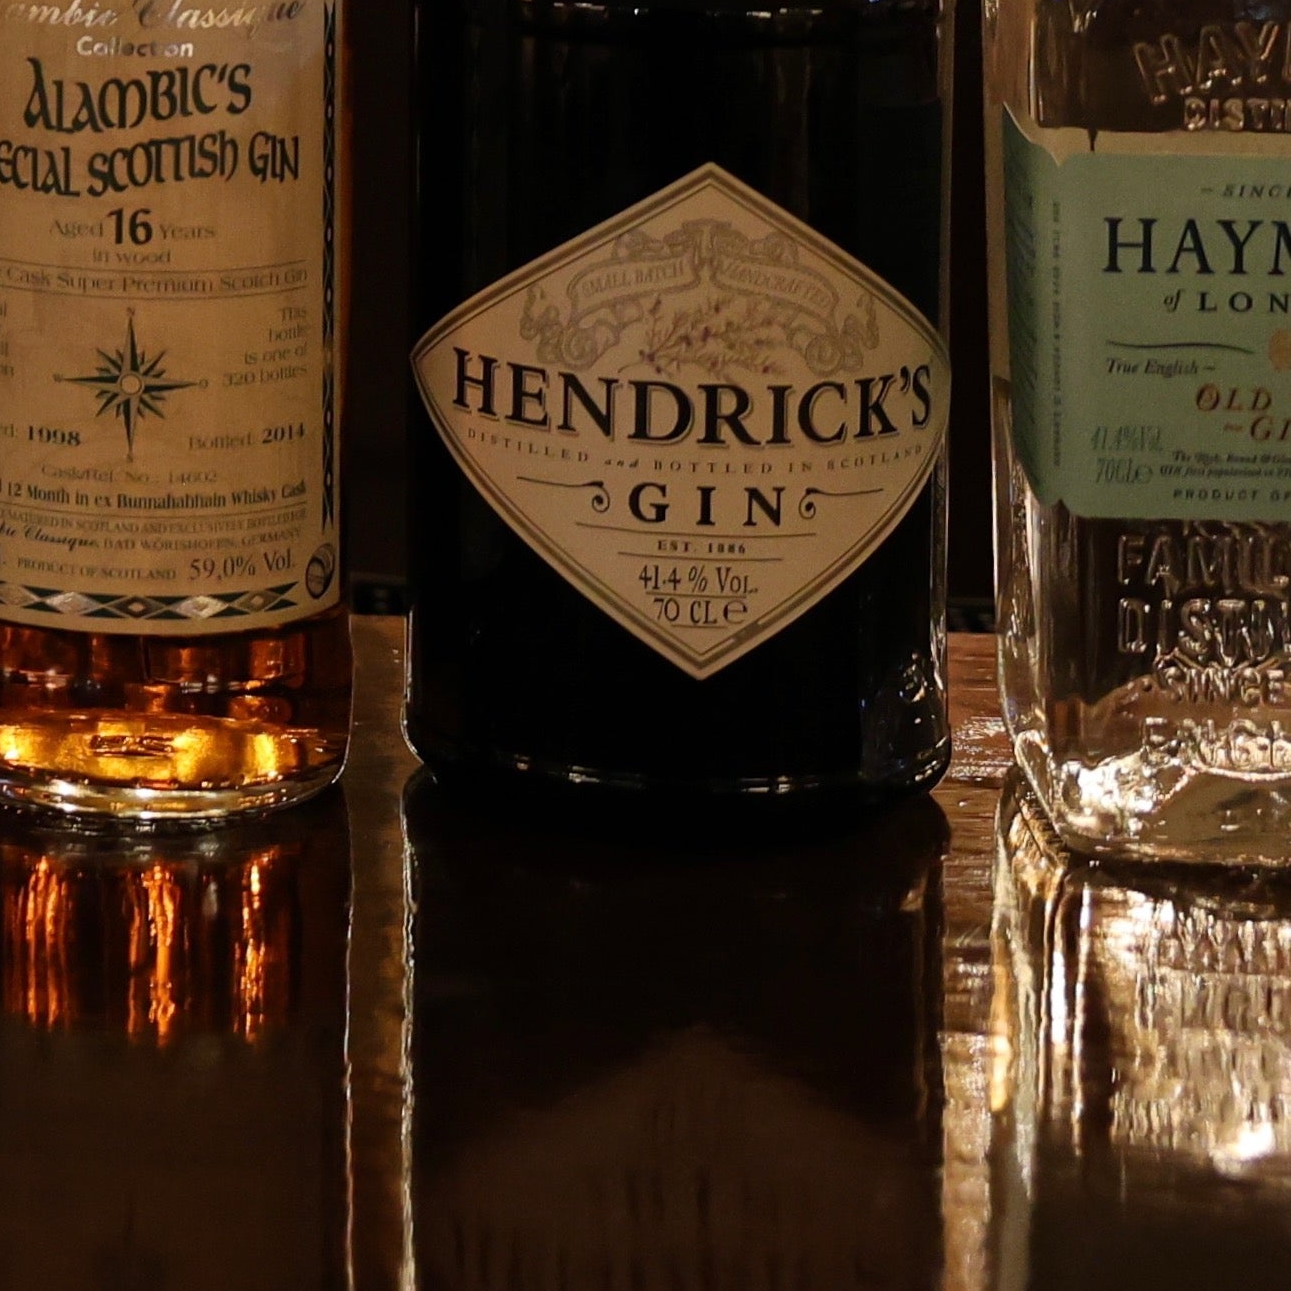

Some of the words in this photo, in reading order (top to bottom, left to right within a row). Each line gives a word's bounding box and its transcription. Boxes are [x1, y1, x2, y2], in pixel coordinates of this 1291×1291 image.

[248, 130, 300, 185] GIN
[49, 219, 105, 240] Aged
[106, 207, 154, 246] 16
[159, 223, 216, 241] Years
[116, 247, 172, 264] wood
[122, 275, 214, 294] Premium
[1163, 288, 1186, 313] of
[1107, 356, 1140, 375] True
[1144, 358, 1199, 379] English
[452, 346, 932, 448] HENDRICK'S
[1195, 382, 1273, 413] OLD
[28, 424, 81, 447] 1998
[261, 421, 306, 445] 2014
[468, 427, 589, 463] DISTILLED
[604, 458, 640, 469] and
[653, 458, 773, 475] BOTTLED
[788, 461, 813, 473] IN
[827, 445, 923, 471] SCOTLAND
[7, 481, 22, 498] 12
[27, 483, 71, 505] Month
[75, 488, 90, 507] in
[93, 493, 112, 509] ex
[116, 491, 227, 510] Bunnahabhain
[231, 485, 276, 506] Whisky
[628, 481, 786, 528] GIN
[1173, 488, 1260, 502] PRODUCT
[188, 554, 257, 582] 59,0%
[652, 597, 681, 623] 70
